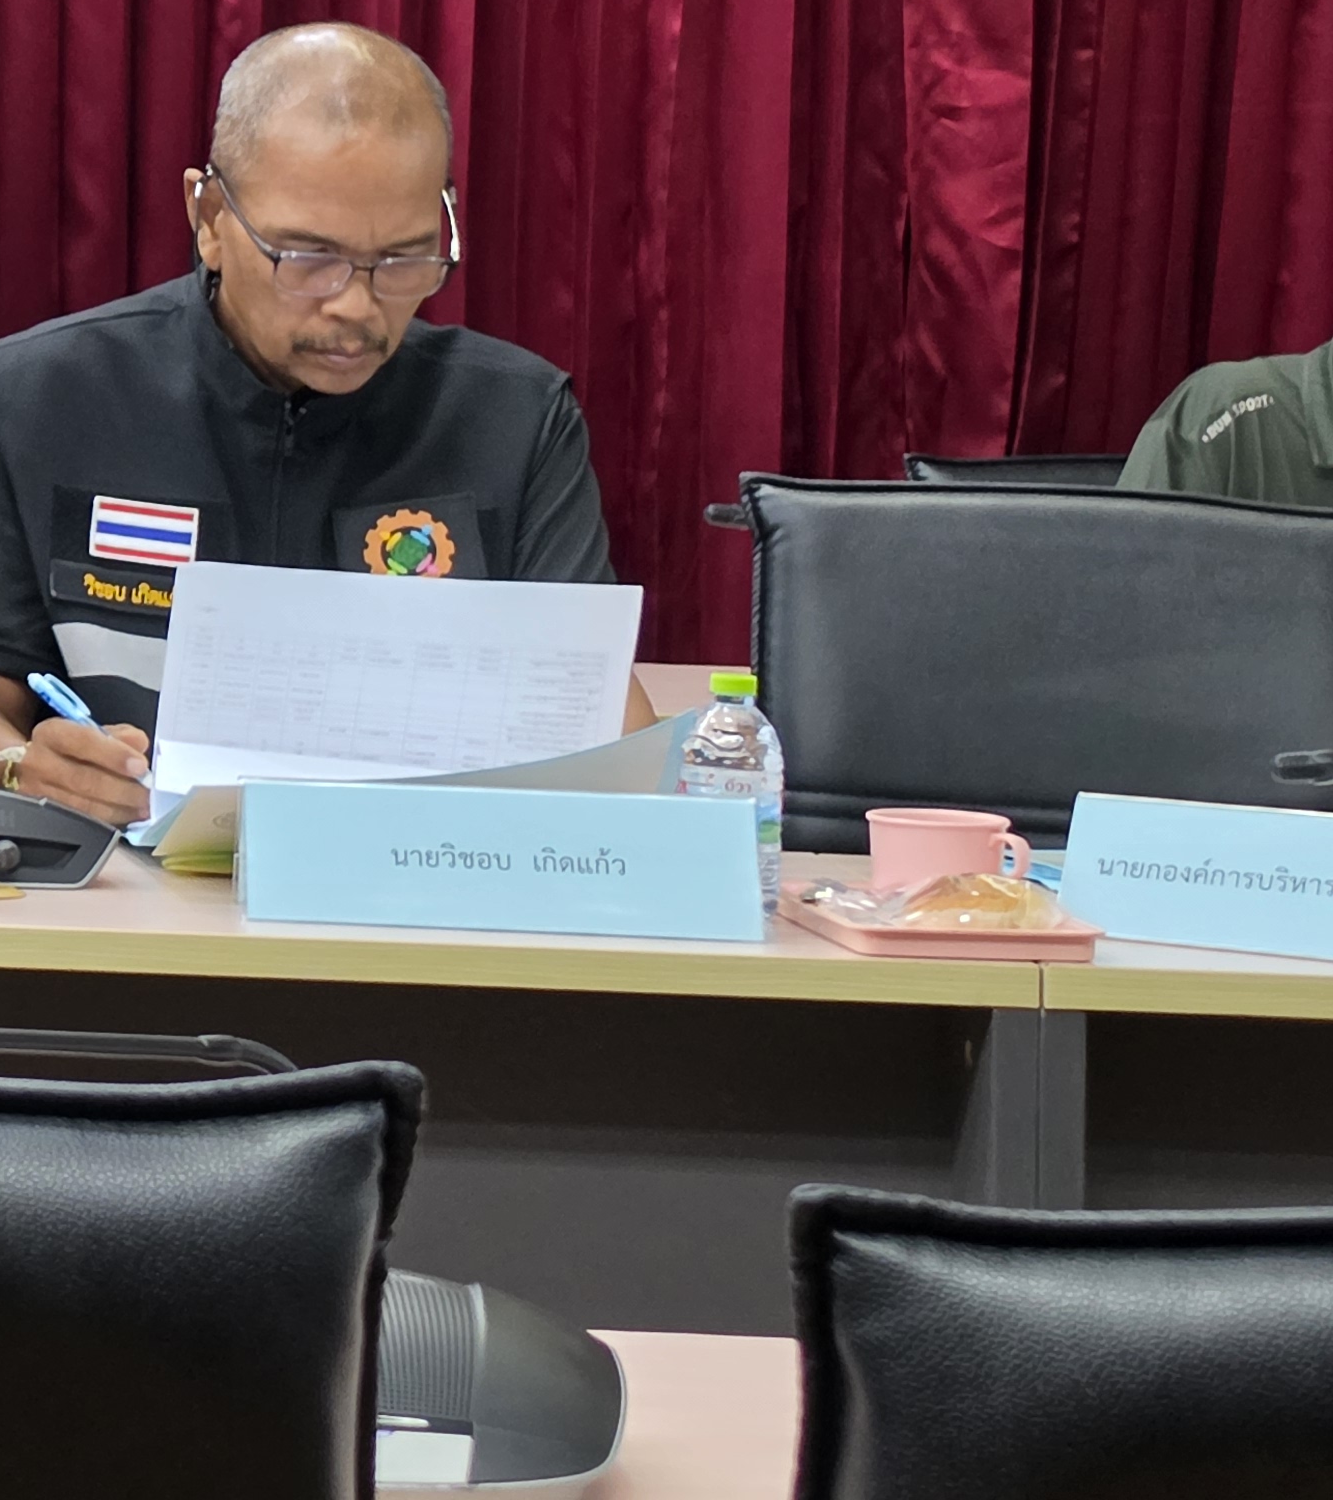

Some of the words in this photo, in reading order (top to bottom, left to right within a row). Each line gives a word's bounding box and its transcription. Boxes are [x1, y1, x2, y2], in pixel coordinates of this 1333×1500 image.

[130, 581, 174, 609] เกิดแ
[390, 841, 512, 872] นายวิชอบ
[533, 846, 627, 877] เกิดแก้ว
